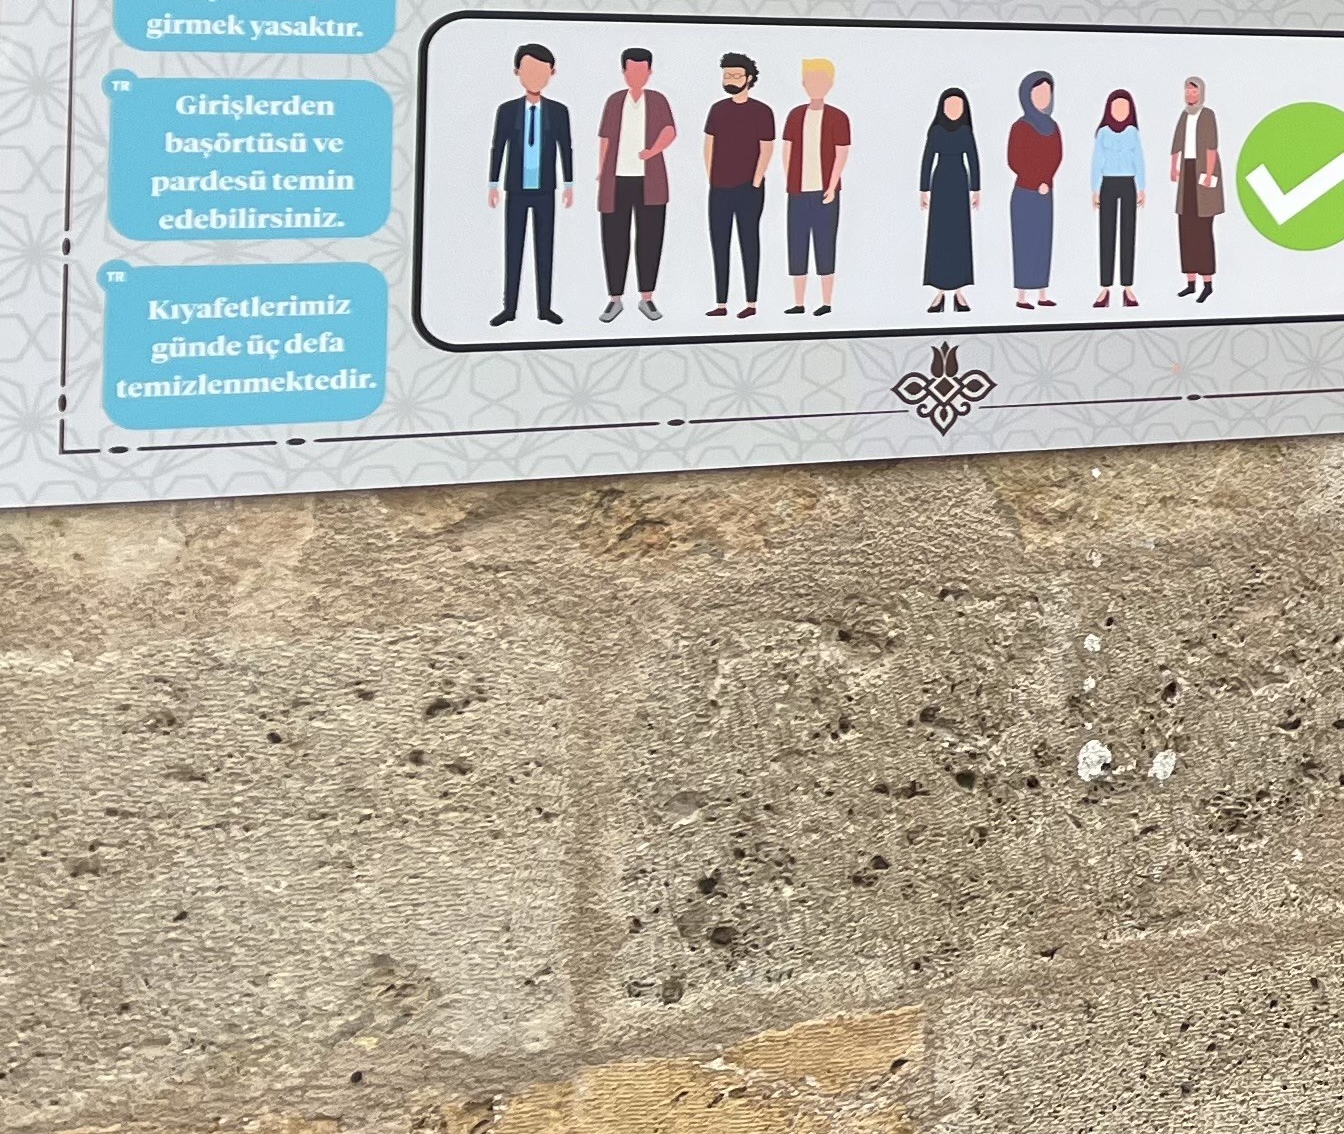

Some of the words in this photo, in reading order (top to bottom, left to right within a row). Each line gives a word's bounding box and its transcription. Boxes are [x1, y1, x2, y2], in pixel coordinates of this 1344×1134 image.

[146, 13, 245, 39] girmek
[250, 15, 363, 40] yasaktır.
[176, 94, 334, 120] Girişlerden
[165, 132, 307, 158] başörtüsü
[313, 137, 343, 152] ve
[151, 170, 266, 197] pardesü
[272, 169, 354, 190] temin
[159, 207, 344, 229] edebilirsiniz.
[148, 294, 350, 324] Kıyafetlerimiz
[151, 335, 241, 364] günde
[247, 334, 280, 359] üç
[284, 331, 344, 353] defa
[117, 368, 377, 398] temizlenmektedir.
